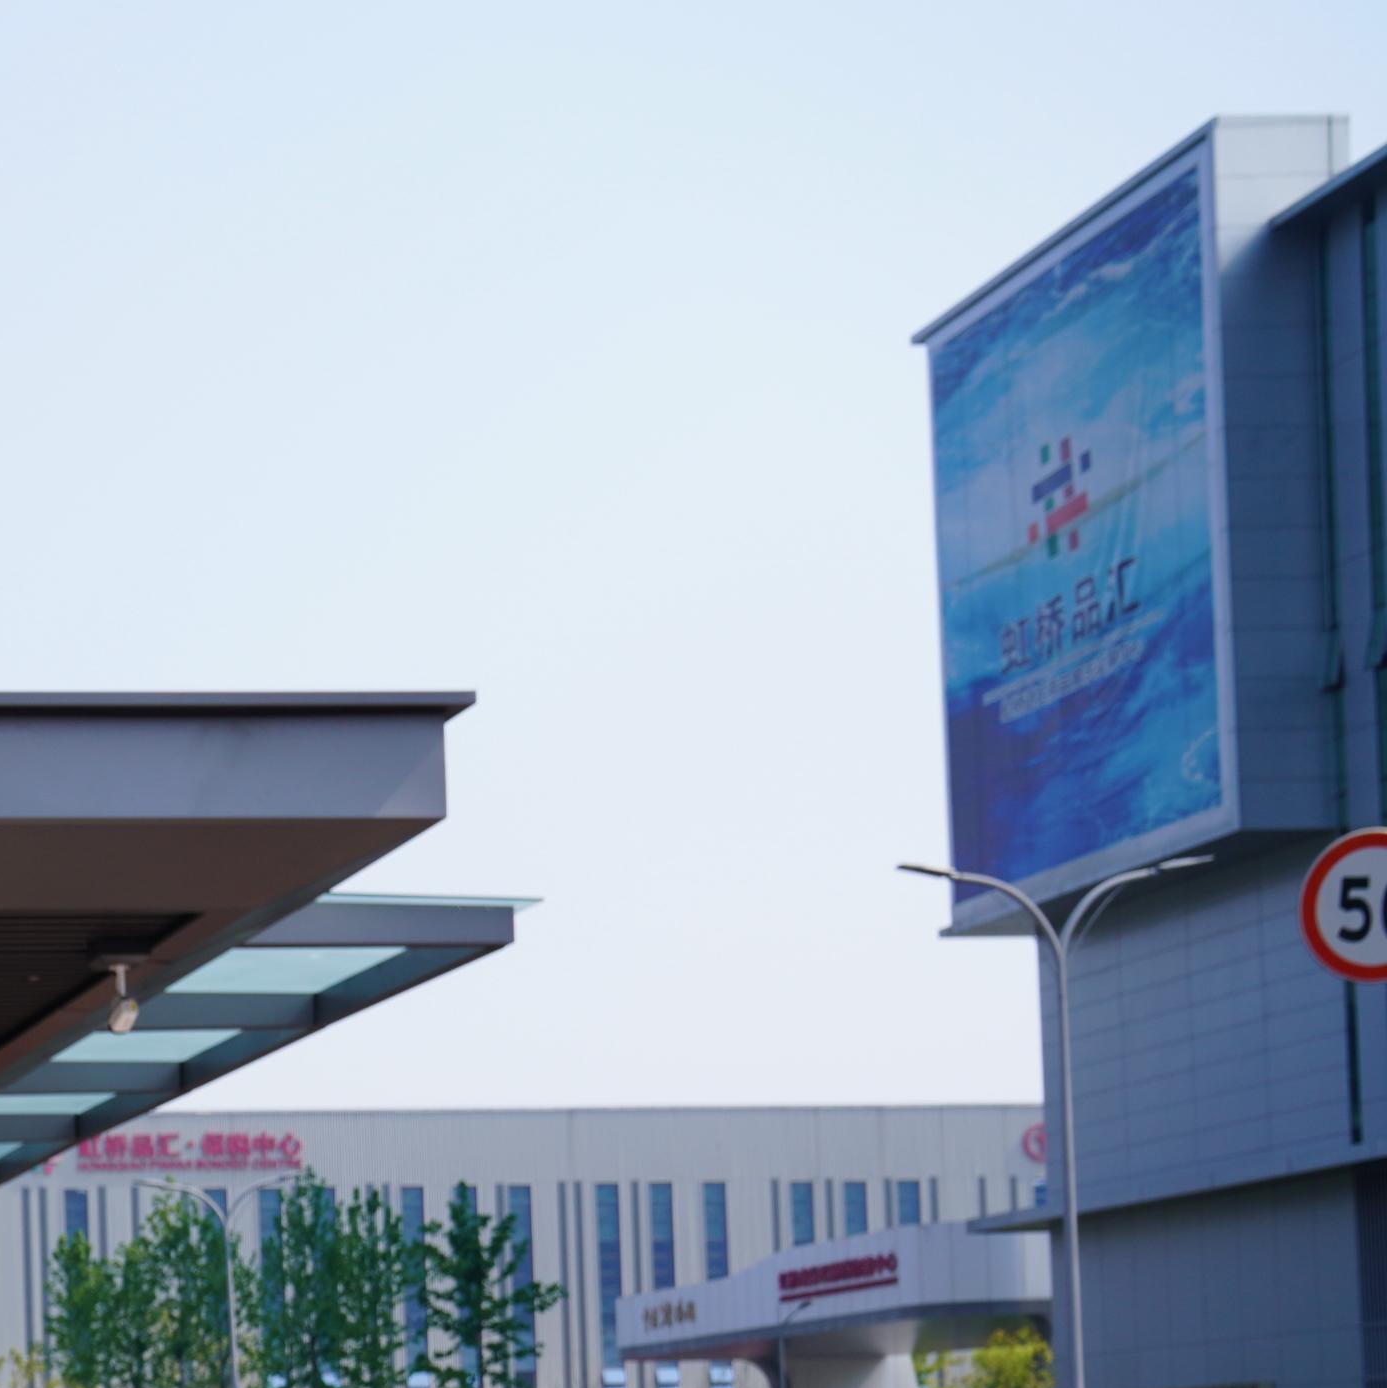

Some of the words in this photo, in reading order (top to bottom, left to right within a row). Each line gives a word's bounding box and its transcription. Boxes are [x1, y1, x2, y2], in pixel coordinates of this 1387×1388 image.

[1001, 558, 1141, 677] 虹桥品汇
[1338, 875, 1387, 943] 5
